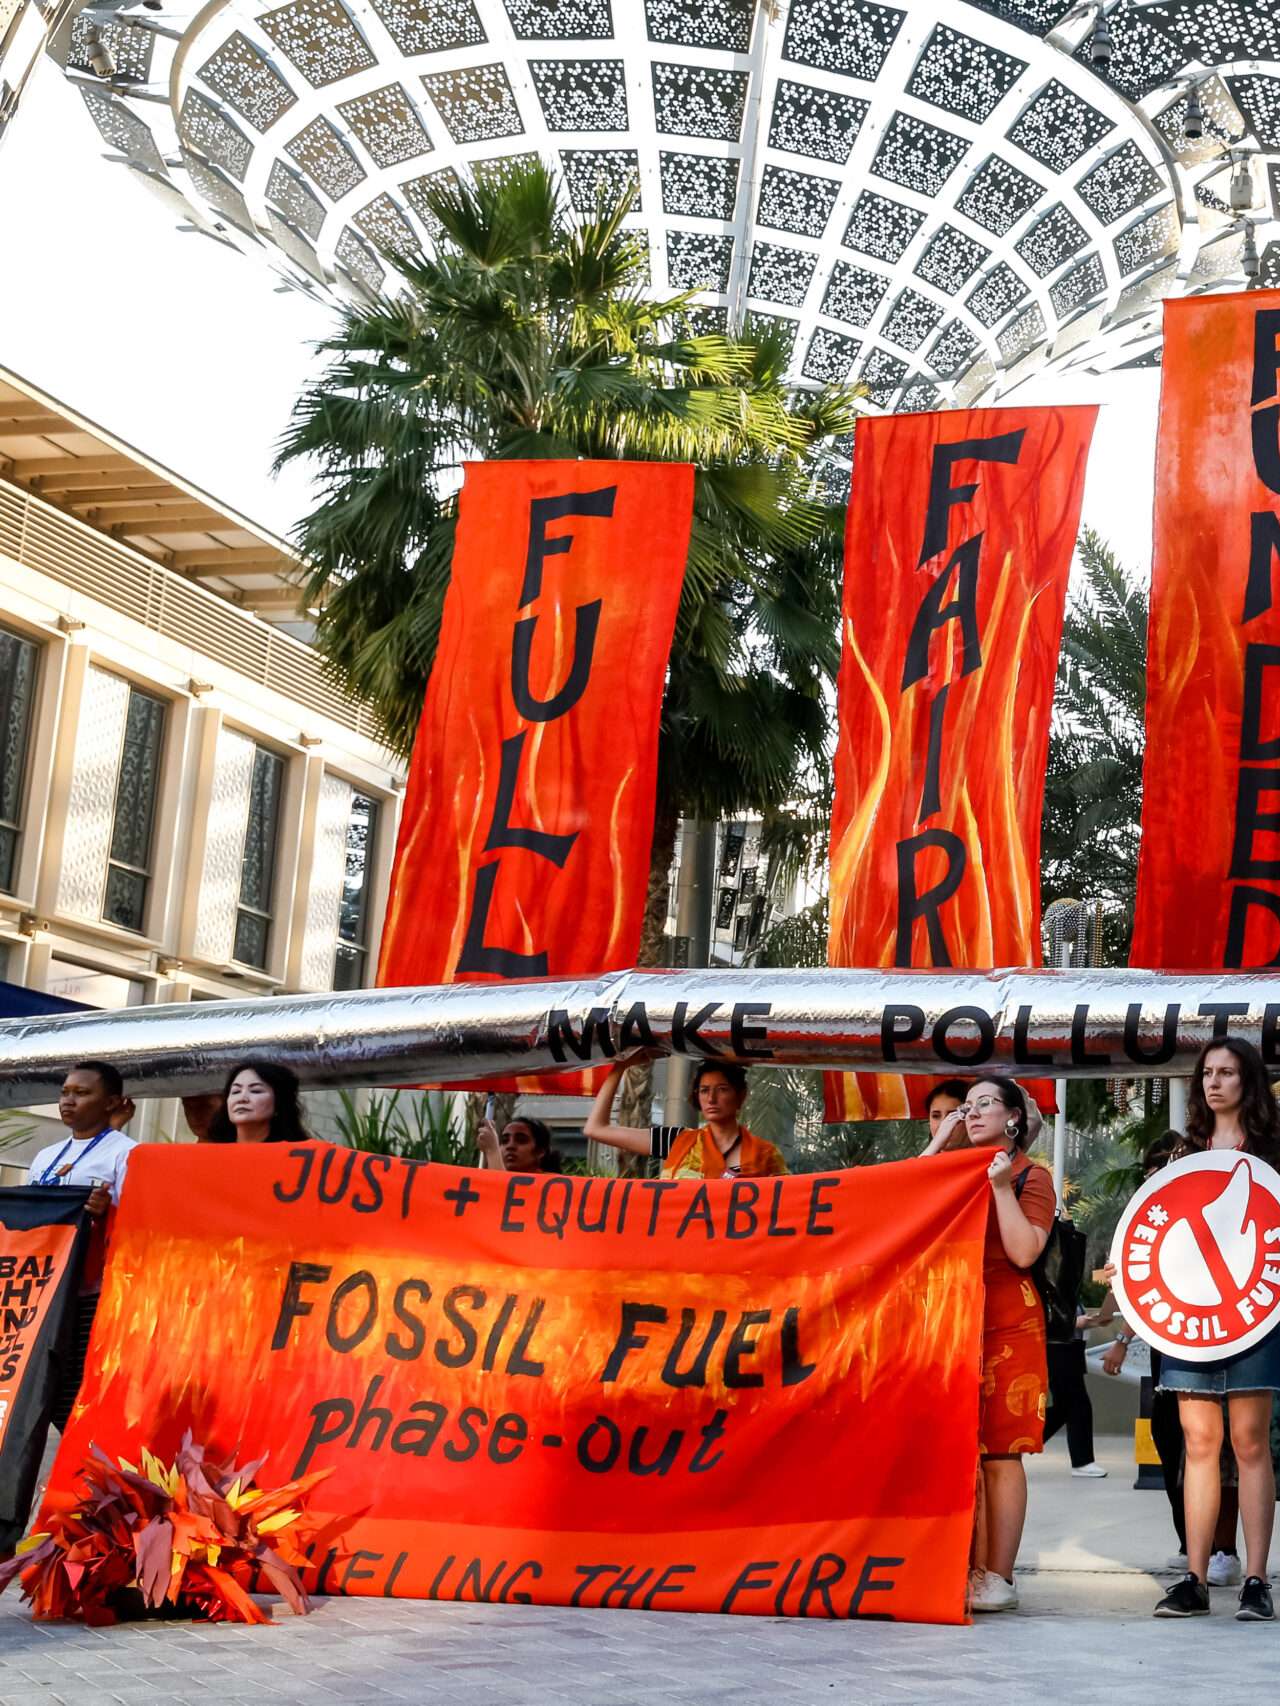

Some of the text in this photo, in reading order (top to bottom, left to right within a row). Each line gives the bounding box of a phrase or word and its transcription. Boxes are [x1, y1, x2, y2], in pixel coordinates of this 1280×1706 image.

[455, 485, 618, 977] FULL
[895, 427, 1027, 968] FAIR
[547, 1001, 774, 1062] MAKE
[273, 1148, 841, 1240] JUST + EQUITABLE
[1128, 1204, 1170, 1282] #END
[271, 1261, 818, 1389] FOSSIL FUEL
[1138, 1288, 1228, 1341] FOSSIL
[290, 1374, 729, 1482] phase-out
[570, 1564, 696, 1611] THE
[718, 1552, 905, 1622] FIRE
